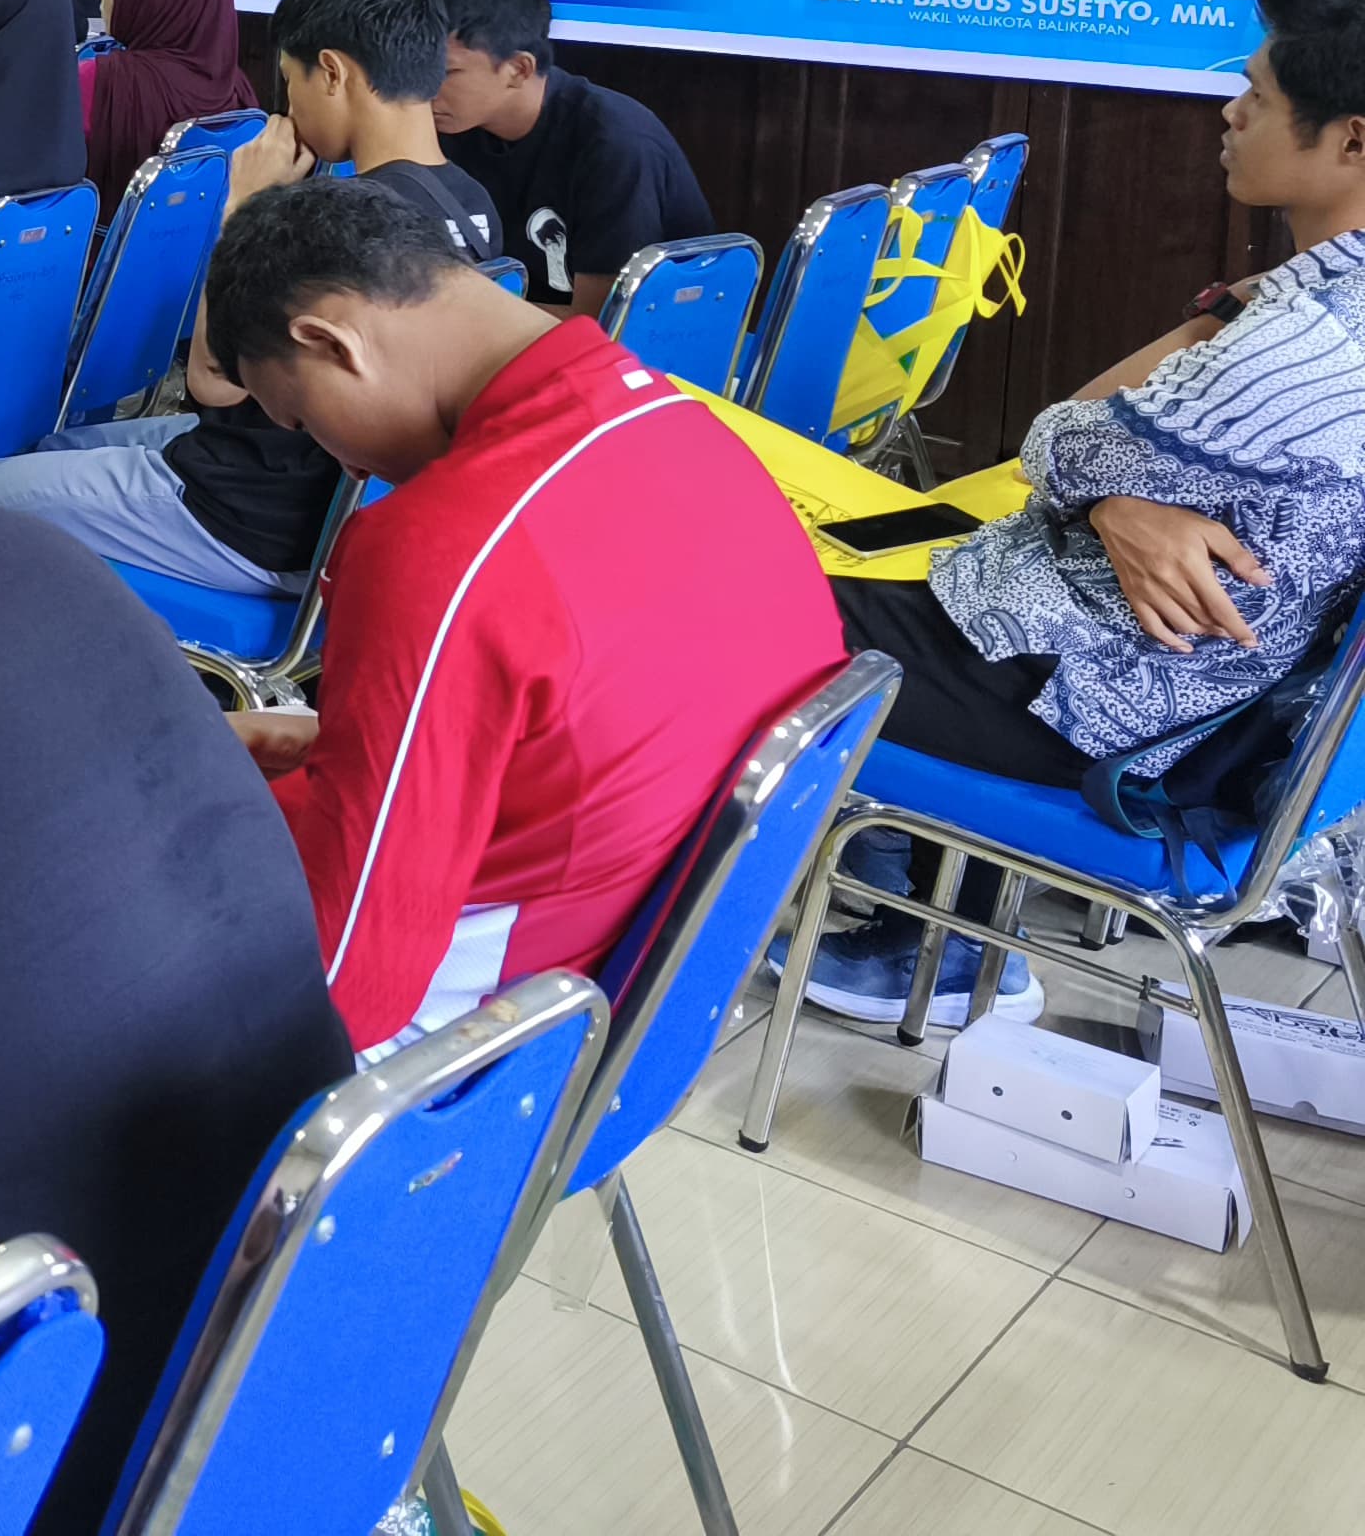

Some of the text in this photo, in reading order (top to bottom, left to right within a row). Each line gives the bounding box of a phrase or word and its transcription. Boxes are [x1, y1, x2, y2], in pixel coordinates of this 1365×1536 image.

[908, 11, 1130, 36] WAKIL WALIKOTA BALIKPAPAN
[1170, 2, 1235, 28] MM.
